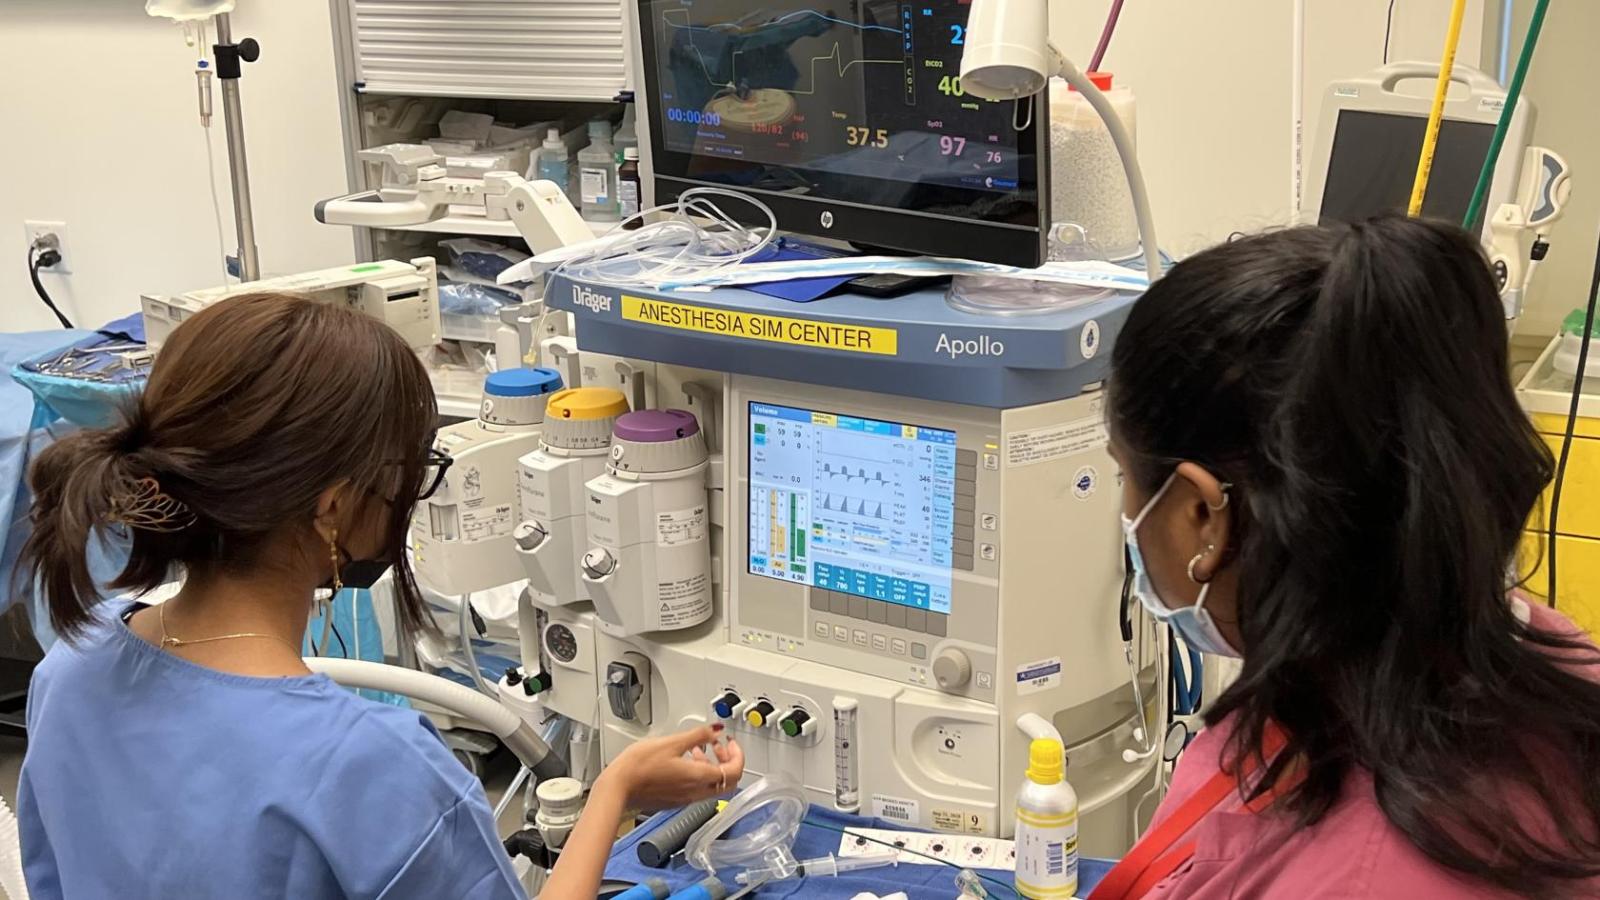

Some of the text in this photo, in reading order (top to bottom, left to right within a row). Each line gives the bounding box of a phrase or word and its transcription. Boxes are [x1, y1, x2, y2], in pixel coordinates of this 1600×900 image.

[950, 24, 967, 45] 2
[938, 76, 966, 96] 40
[667, 108, 720, 126] 00:00:00
[846, 126, 888, 149] 37.5
[940, 135, 966, 156] 97
[986, 151, 1002, 164] 76
[572, 284, 612, 313] Dräger
[639, 302, 872, 349] ANESTHESIA SIM CENTER
[934, 333, 1004, 360] Apollo
[754, 405, 778, 415] Volume
[972, 814, 979, 826] 9
